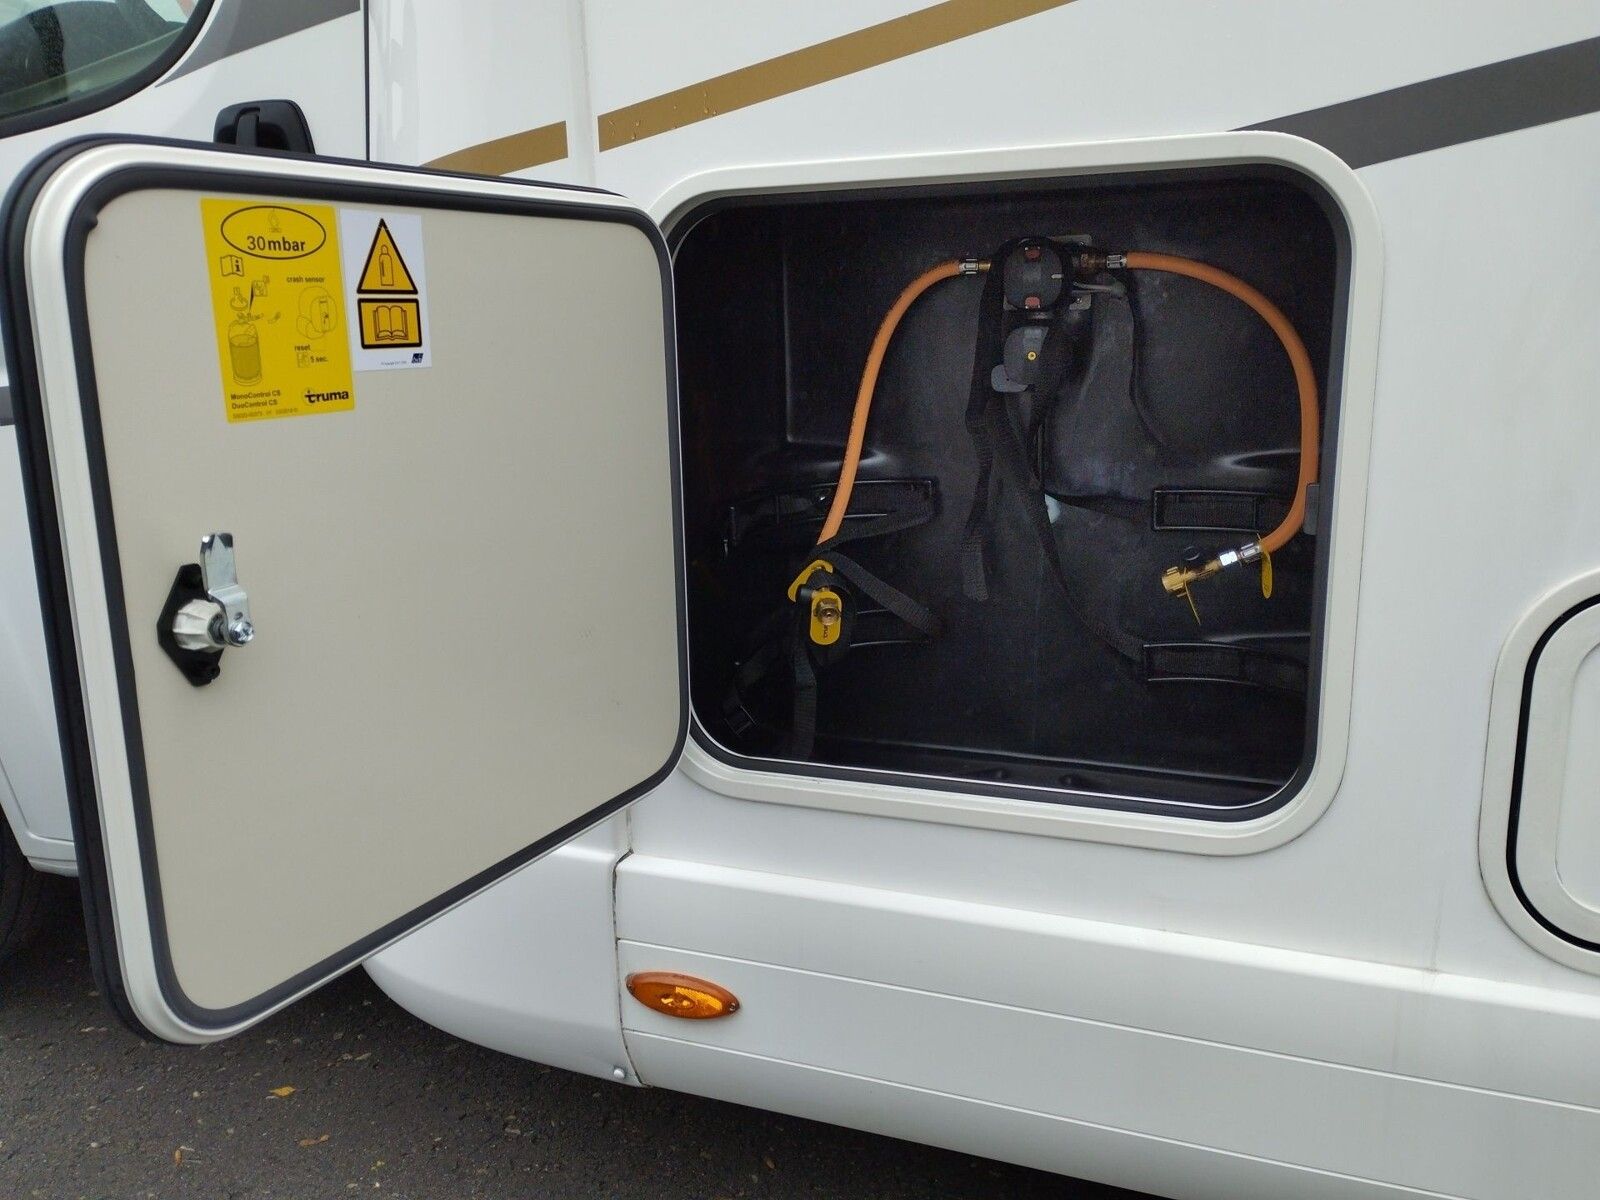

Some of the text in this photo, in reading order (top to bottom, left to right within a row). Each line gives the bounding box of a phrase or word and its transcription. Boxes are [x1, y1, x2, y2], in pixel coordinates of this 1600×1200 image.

[286, 275, 304, 283] crash
[294, 344, 311, 352] reset
[310, 355, 315, 363] 5
[304, 389, 350, 404] truma
